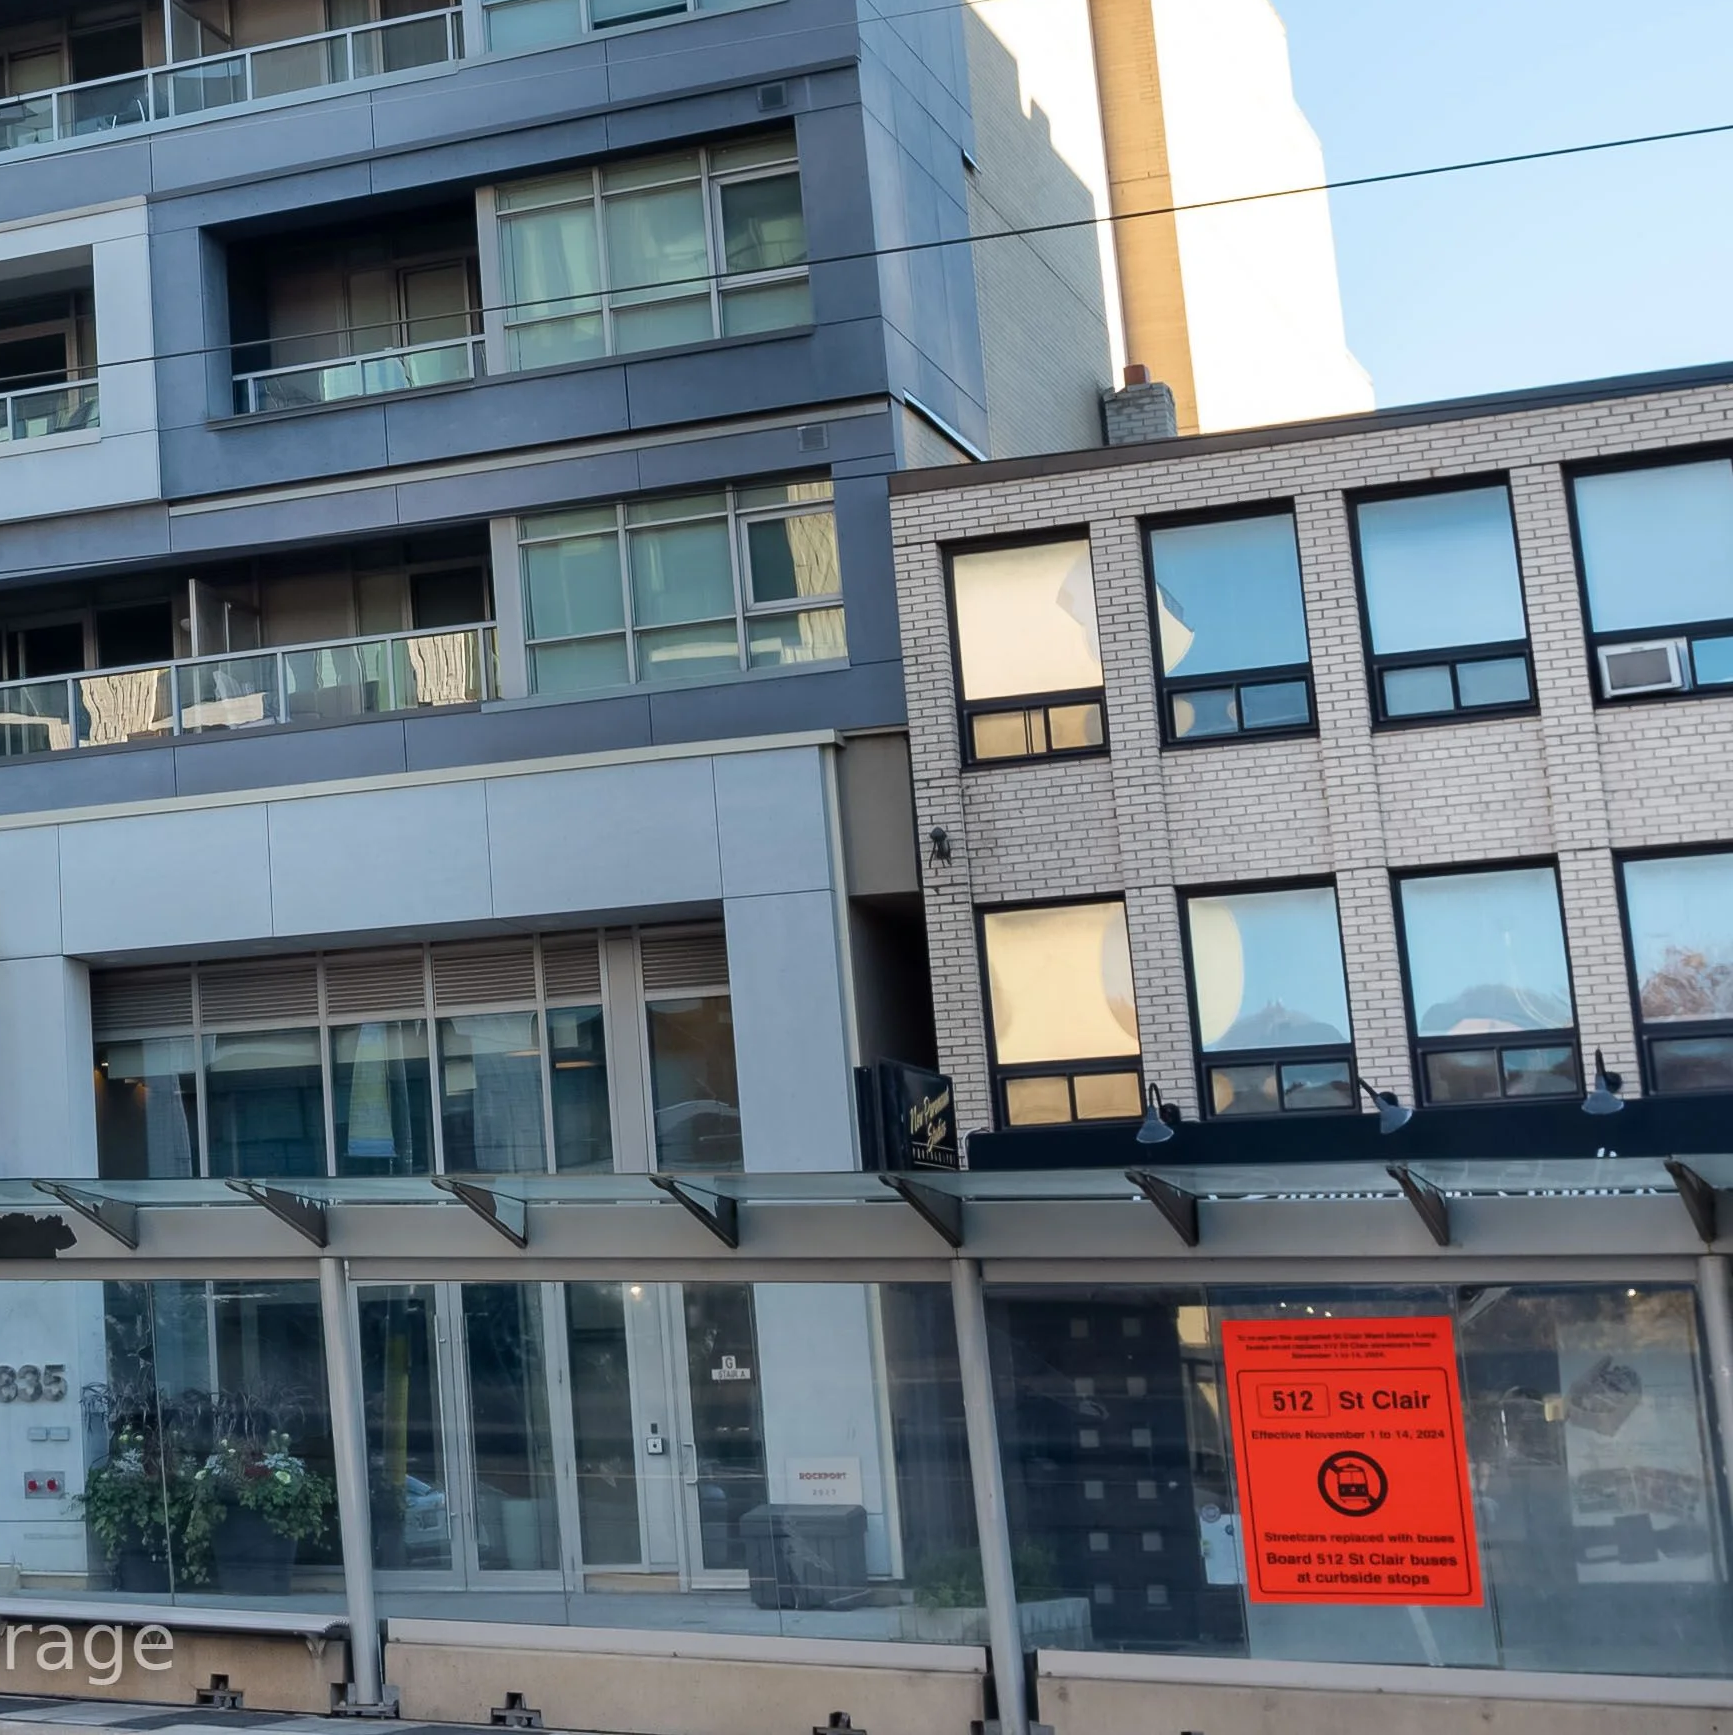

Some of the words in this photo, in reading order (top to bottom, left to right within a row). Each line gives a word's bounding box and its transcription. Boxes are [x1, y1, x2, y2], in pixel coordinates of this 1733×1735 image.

[725, 1357, 734, 1369] G
[1272, 1390, 1314, 1412] 512
[1338, 1390, 1365, 1410] St
[1372, 1390, 1431, 1410] Clair
[1251, 1429, 1301, 1440] Effective
[1305, 1429, 1366, 1440] November
[1379, 1429, 1391, 1440] to
[1396, 1429, 1413, 1440] 14,
[1415, 1429, 1445, 1439] 2024
[798, 1472, 847, 1480] ROCKPORT
[1264, 1532, 1327, 1543] Streetcars
[1330, 1533, 1384, 1545] replaced
[1388, 1533, 1413, 1543] with
[1417, 1534, 1455, 1544] buses
[1266, 1552, 1312, 1565] Board
[1316, 1553, 1343, 1565] 512
[1348, 1553, 1364, 1565] St
[1368, 1553, 1404, 1566] Clair
[1410, 1553, 1458, 1566] buses
[1297, 1572, 1311, 1584] at
[1315, 1571, 1382, 1584] curbside
[1387, 1573, 1430, 1586] stops
